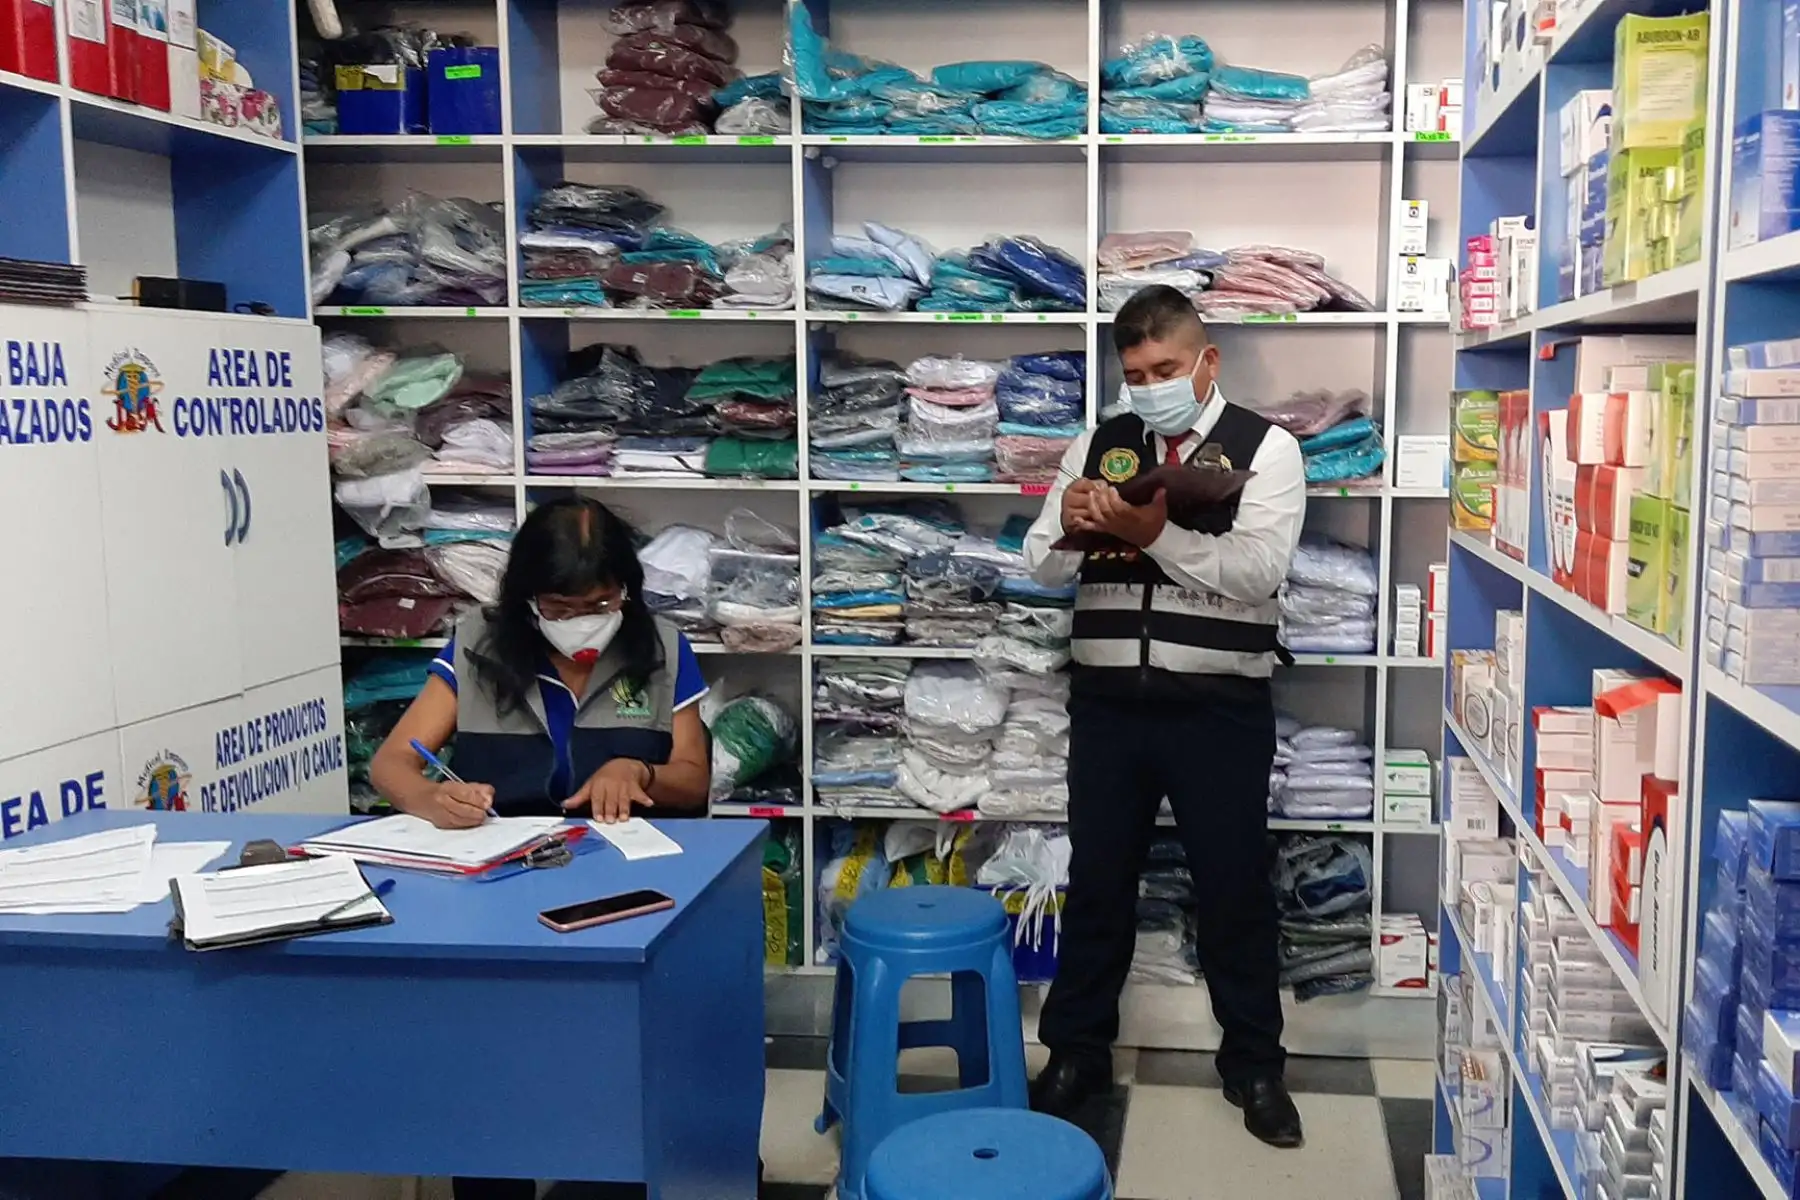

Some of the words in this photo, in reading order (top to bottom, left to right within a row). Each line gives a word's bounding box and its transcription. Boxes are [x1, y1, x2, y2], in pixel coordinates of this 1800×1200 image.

[7, 341, 67, 386] BAJA
[208, 348, 261, 387] AREA
[265, 350, 292, 387] DE
[216, 724, 246, 770] AREA
[248, 718, 263, 756] DE
[264, 697, 326, 751] PRODUCTOS
[60, 770, 106, 818] DE
[201, 782, 218, 813] DE
[219, 754, 290, 813] DEVOLUCION
[312, 734, 342, 777] CANJE
